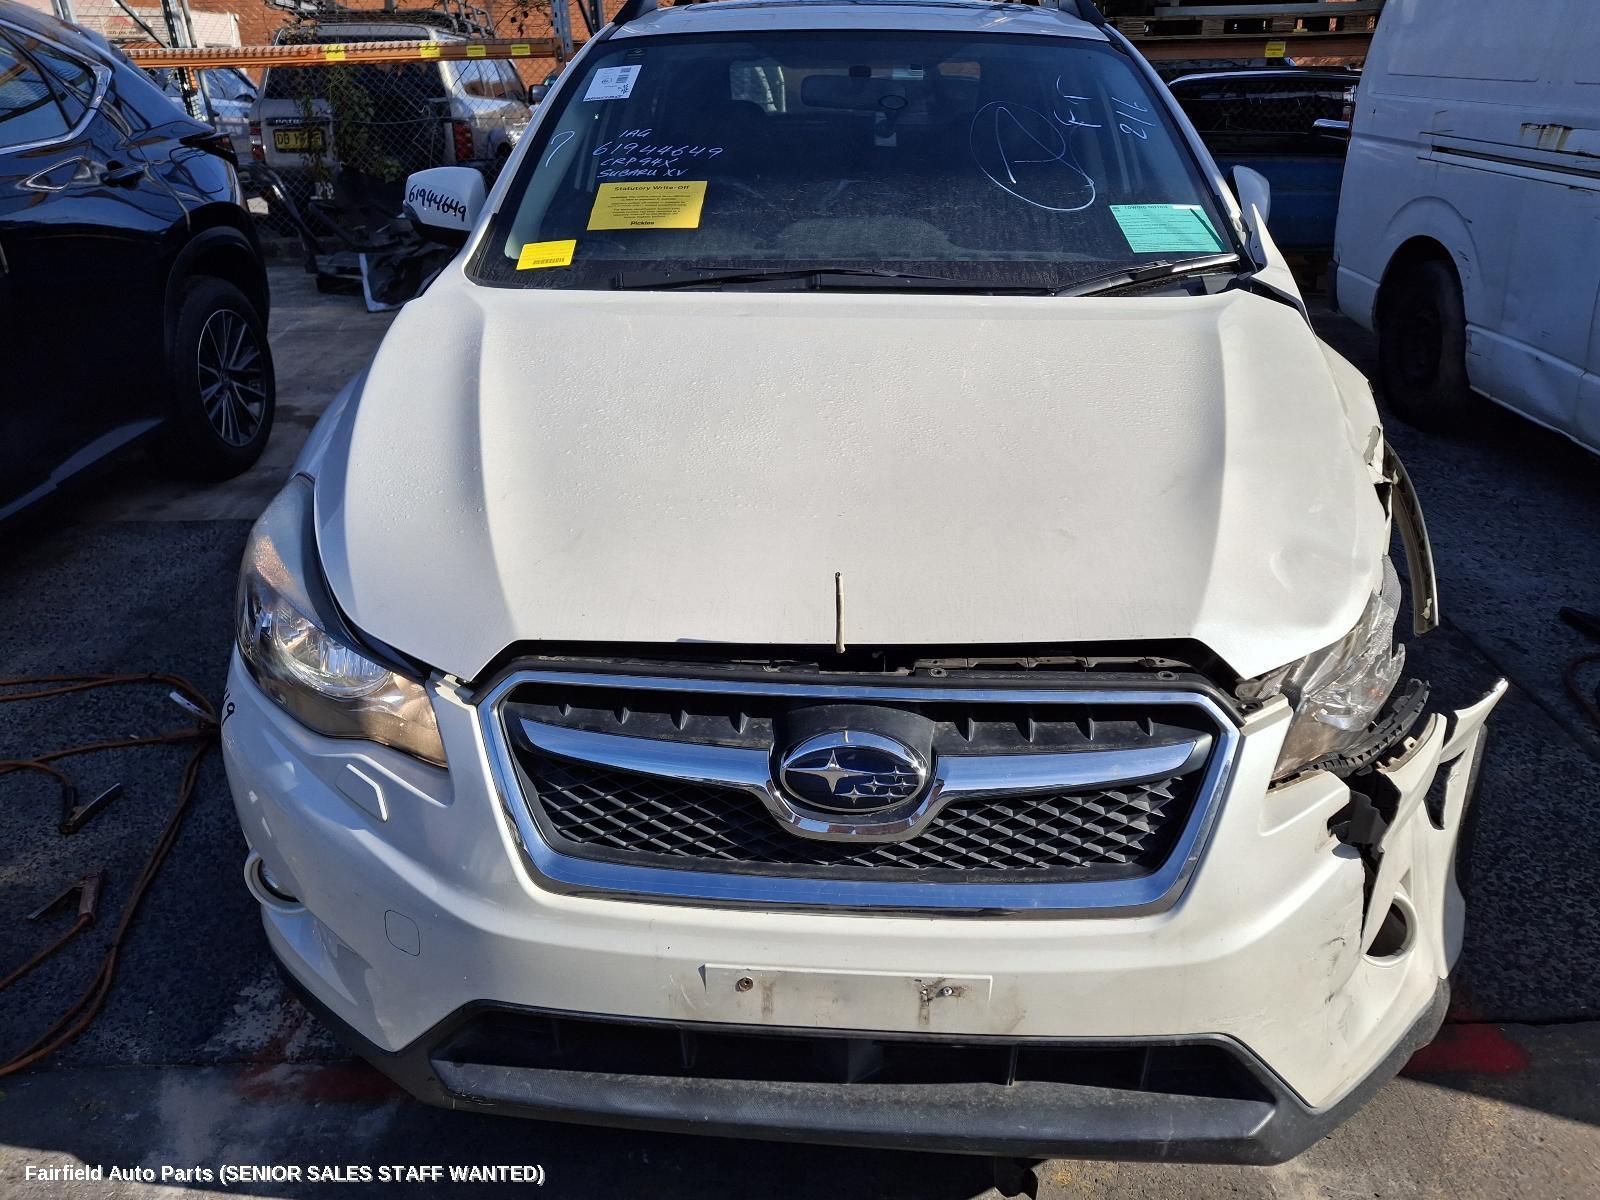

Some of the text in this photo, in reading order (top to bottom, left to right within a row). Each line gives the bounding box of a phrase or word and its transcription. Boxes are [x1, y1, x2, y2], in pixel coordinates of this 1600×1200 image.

[592, 141, 723, 160] 61944649
[596, 168, 689, 179] SUBARU XV
[408, 184, 467, 222] 61944649
